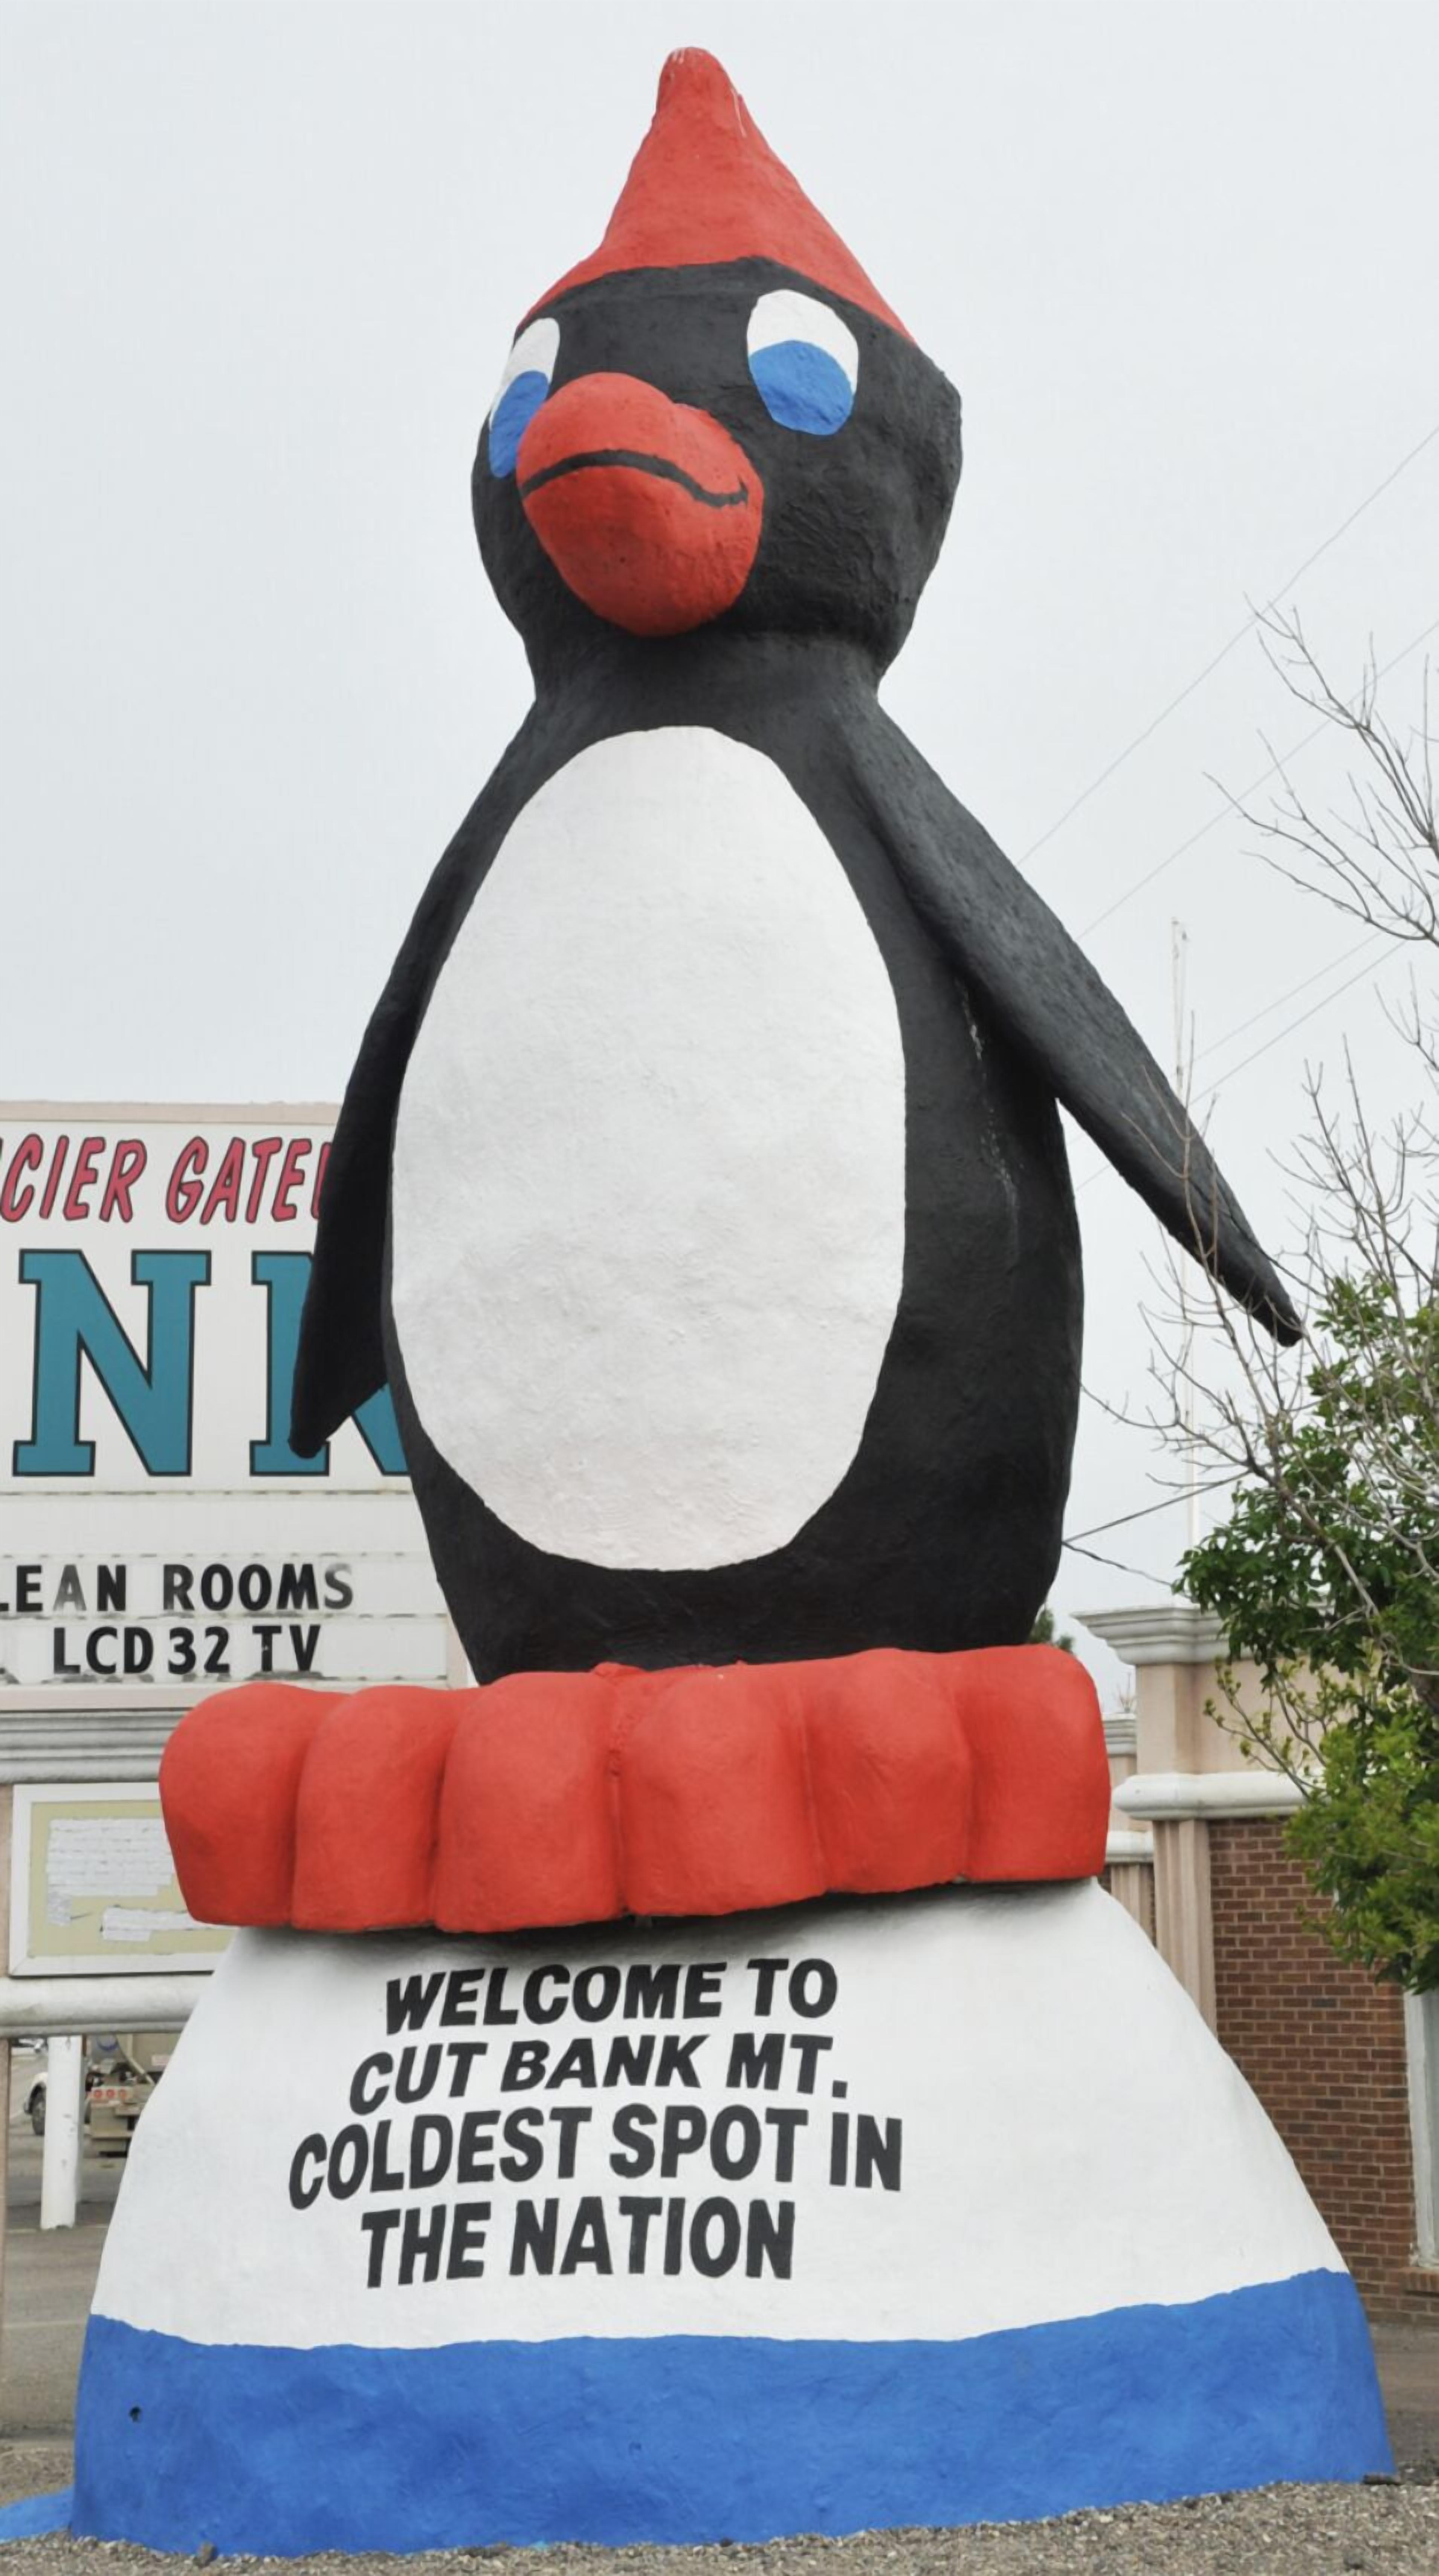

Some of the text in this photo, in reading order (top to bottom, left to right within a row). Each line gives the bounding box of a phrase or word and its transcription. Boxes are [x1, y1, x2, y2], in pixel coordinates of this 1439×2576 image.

[0, 1134, 332, 1225] CIER GATE
[163, 1563, 354, 1612] ROOMS
[53, 1625, 321, 1675] LCD 32 TV
[386, 1958, 837, 2034] WELCOME TO
[350, 2033, 848, 2115] CUT BANK MT.
[289, 2104, 902, 2210] COLDEST SPOT IN
[362, 2196, 795, 2288] THE NATION
